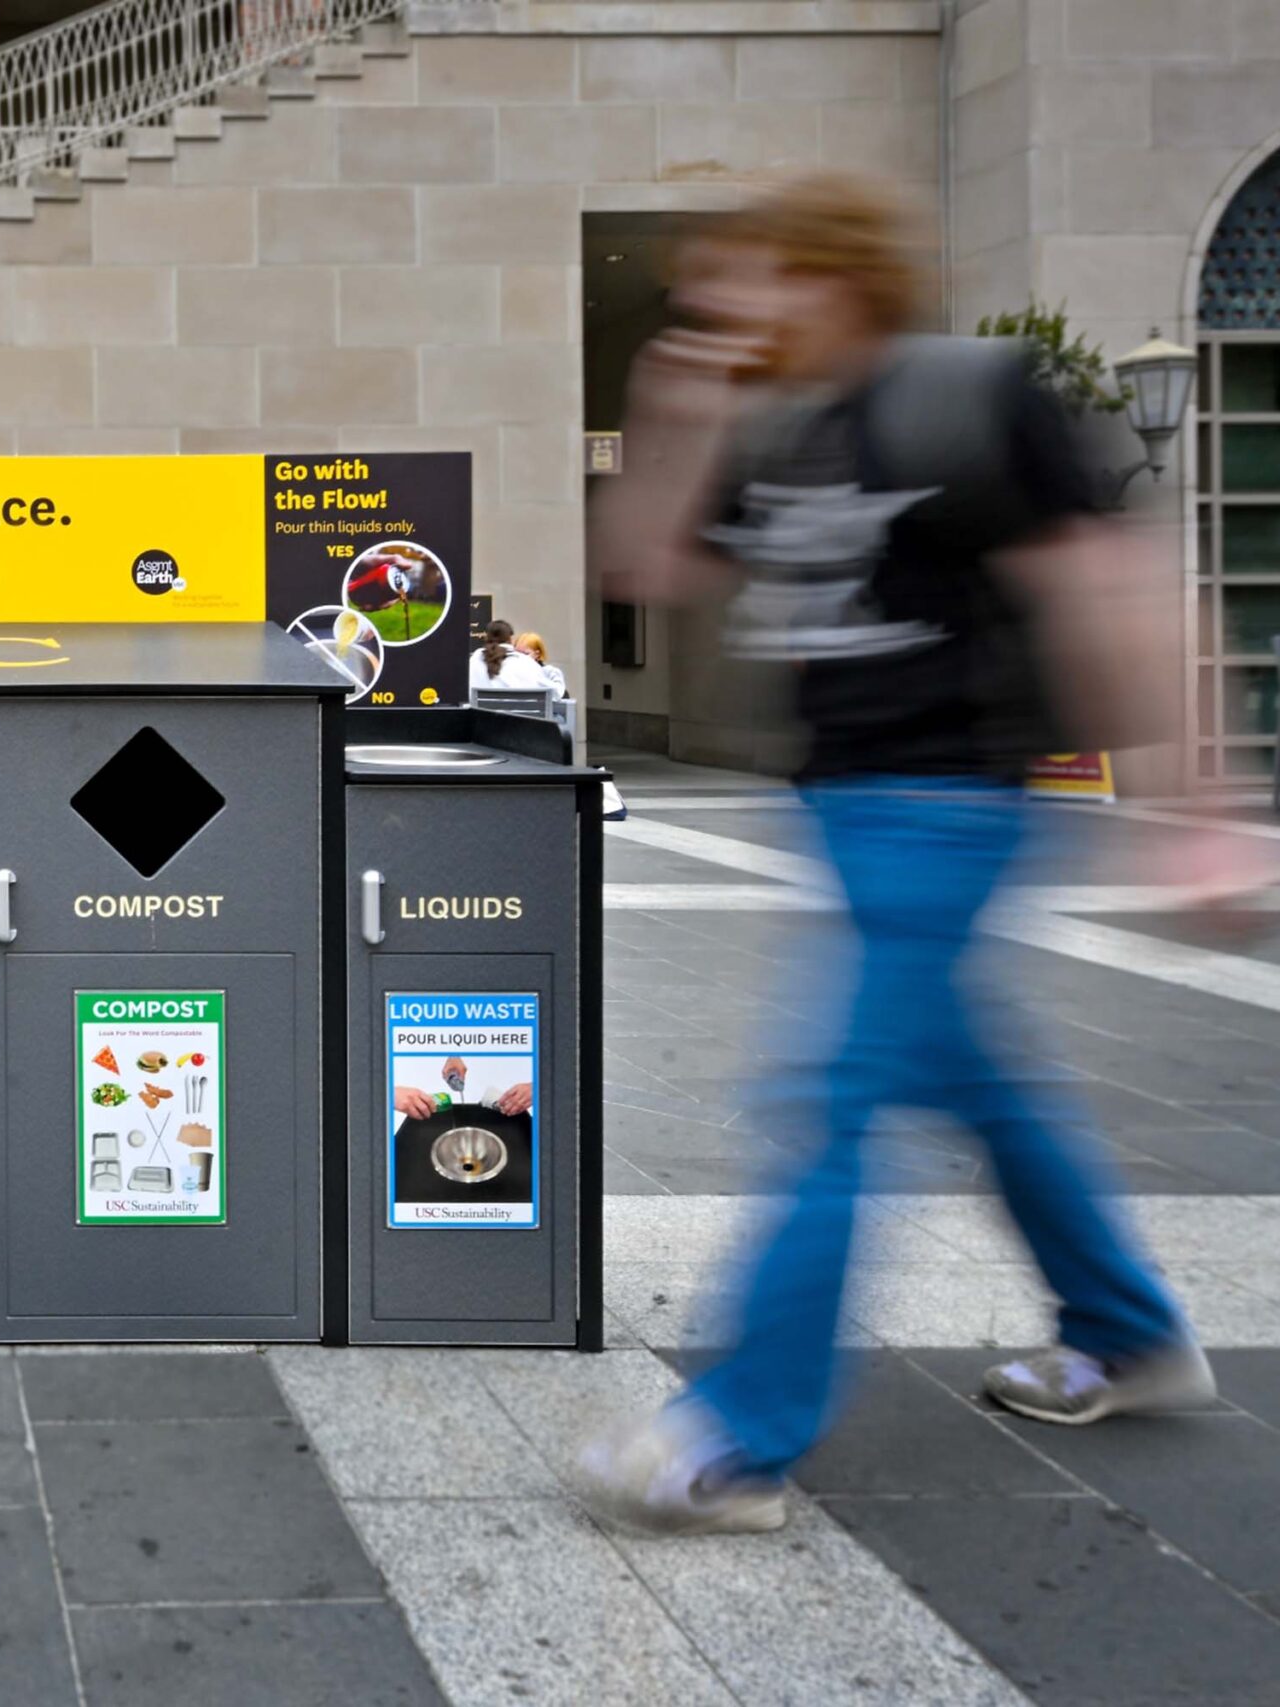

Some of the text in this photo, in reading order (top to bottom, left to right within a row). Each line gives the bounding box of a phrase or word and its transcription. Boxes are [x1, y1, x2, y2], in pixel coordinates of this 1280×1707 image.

[275, 459, 368, 480] Go with
[275, 489, 386, 510] the Flow!
[276, 520, 415, 535] Pour thin liquids only.
[327, 545, 354, 557] YES
[137, 560, 172, 574] Asgmt
[137, 572, 172, 583] Earth
[372, 692, 394, 703] NO
[74, 896, 223, 920] COMPOST
[401, 897, 522, 919] LIQUIDS
[93, 1001, 208, 1018] COMPOST
[389, 1002, 535, 1022] LIQUID WASTE
[398, 1034, 527, 1046] POUR LIQUID HERE
[106, 1201, 198, 1213] USC Sustainability
[416, 1207, 512, 1221] USC Sustainability
